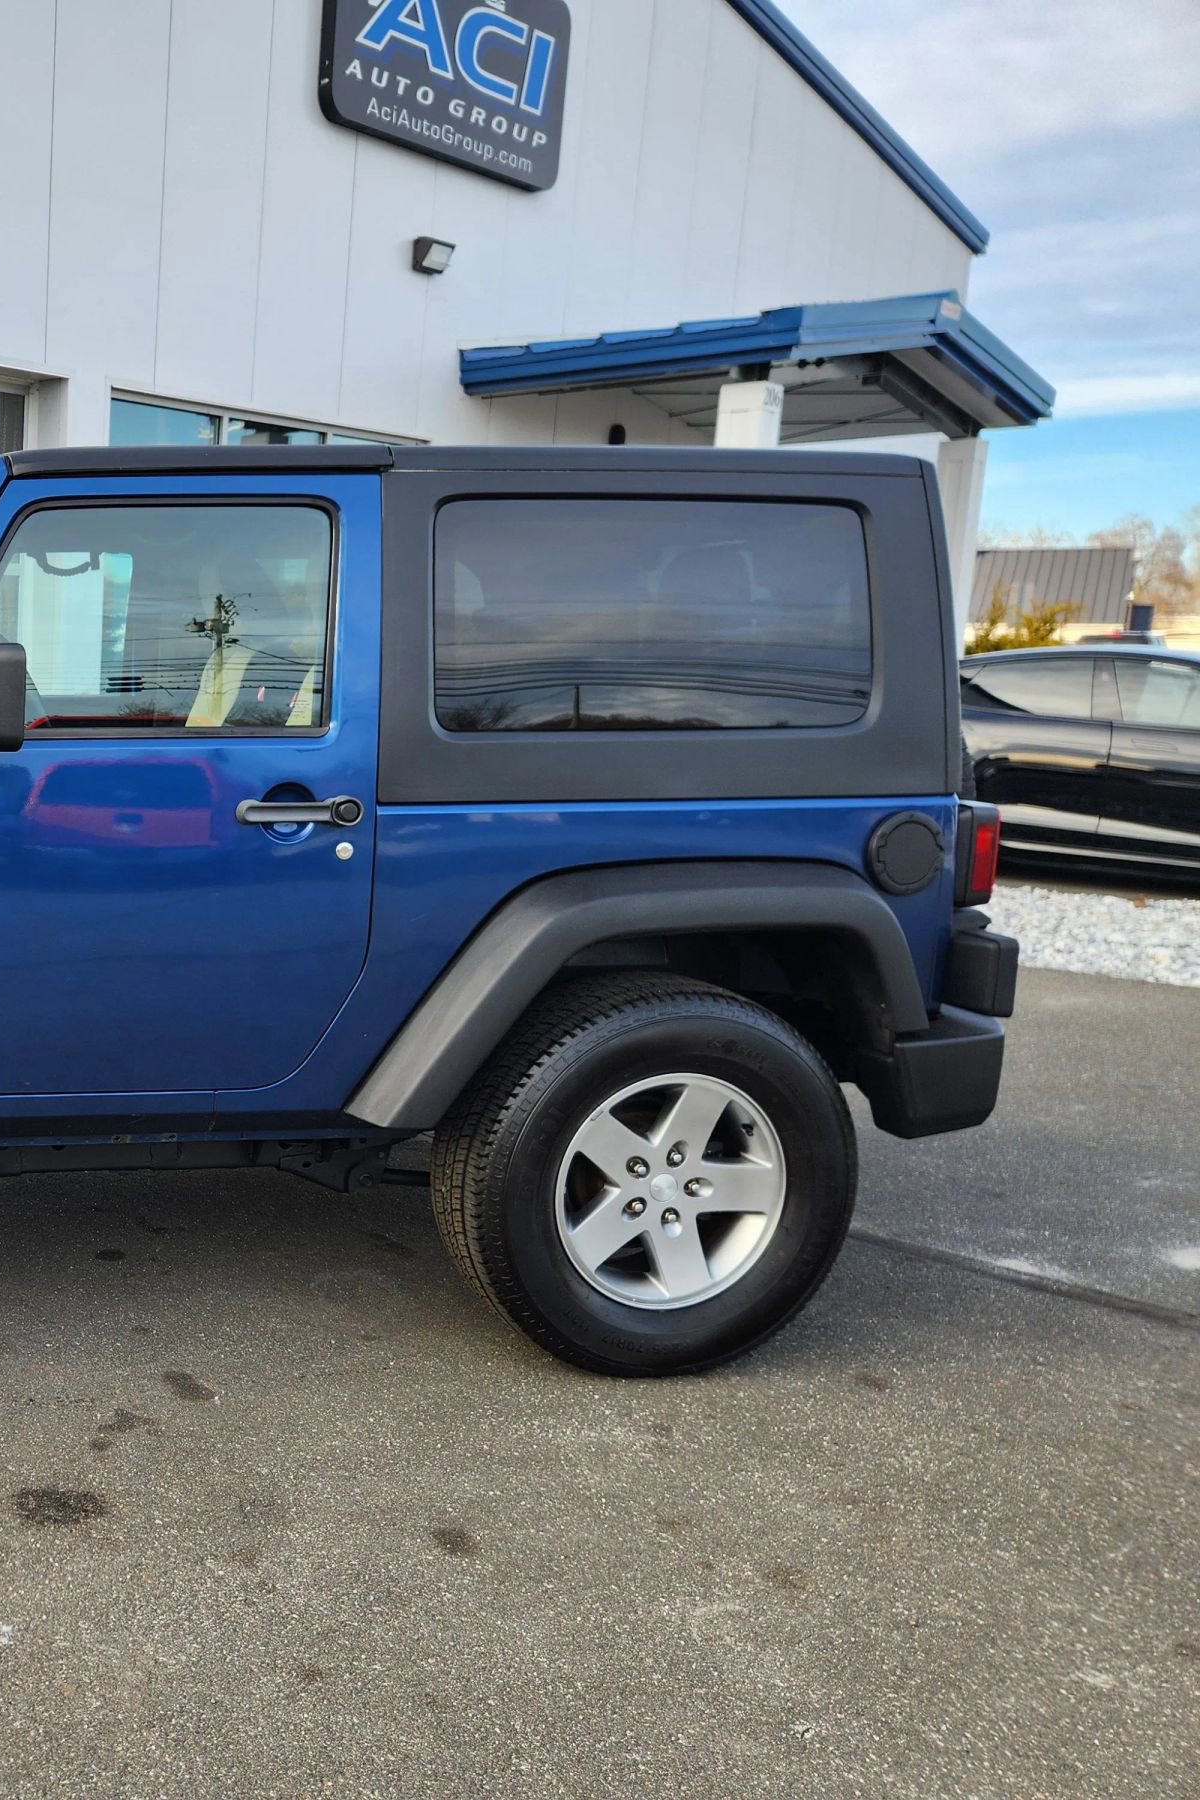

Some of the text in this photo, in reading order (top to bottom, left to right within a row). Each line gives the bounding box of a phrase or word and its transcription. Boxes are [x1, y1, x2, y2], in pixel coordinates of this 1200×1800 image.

[345, 58, 548, 148] AUTO GROUP
[355, 0, 555, 116] ACI
[366, 97, 533, 173] AciAutoGroup.com
